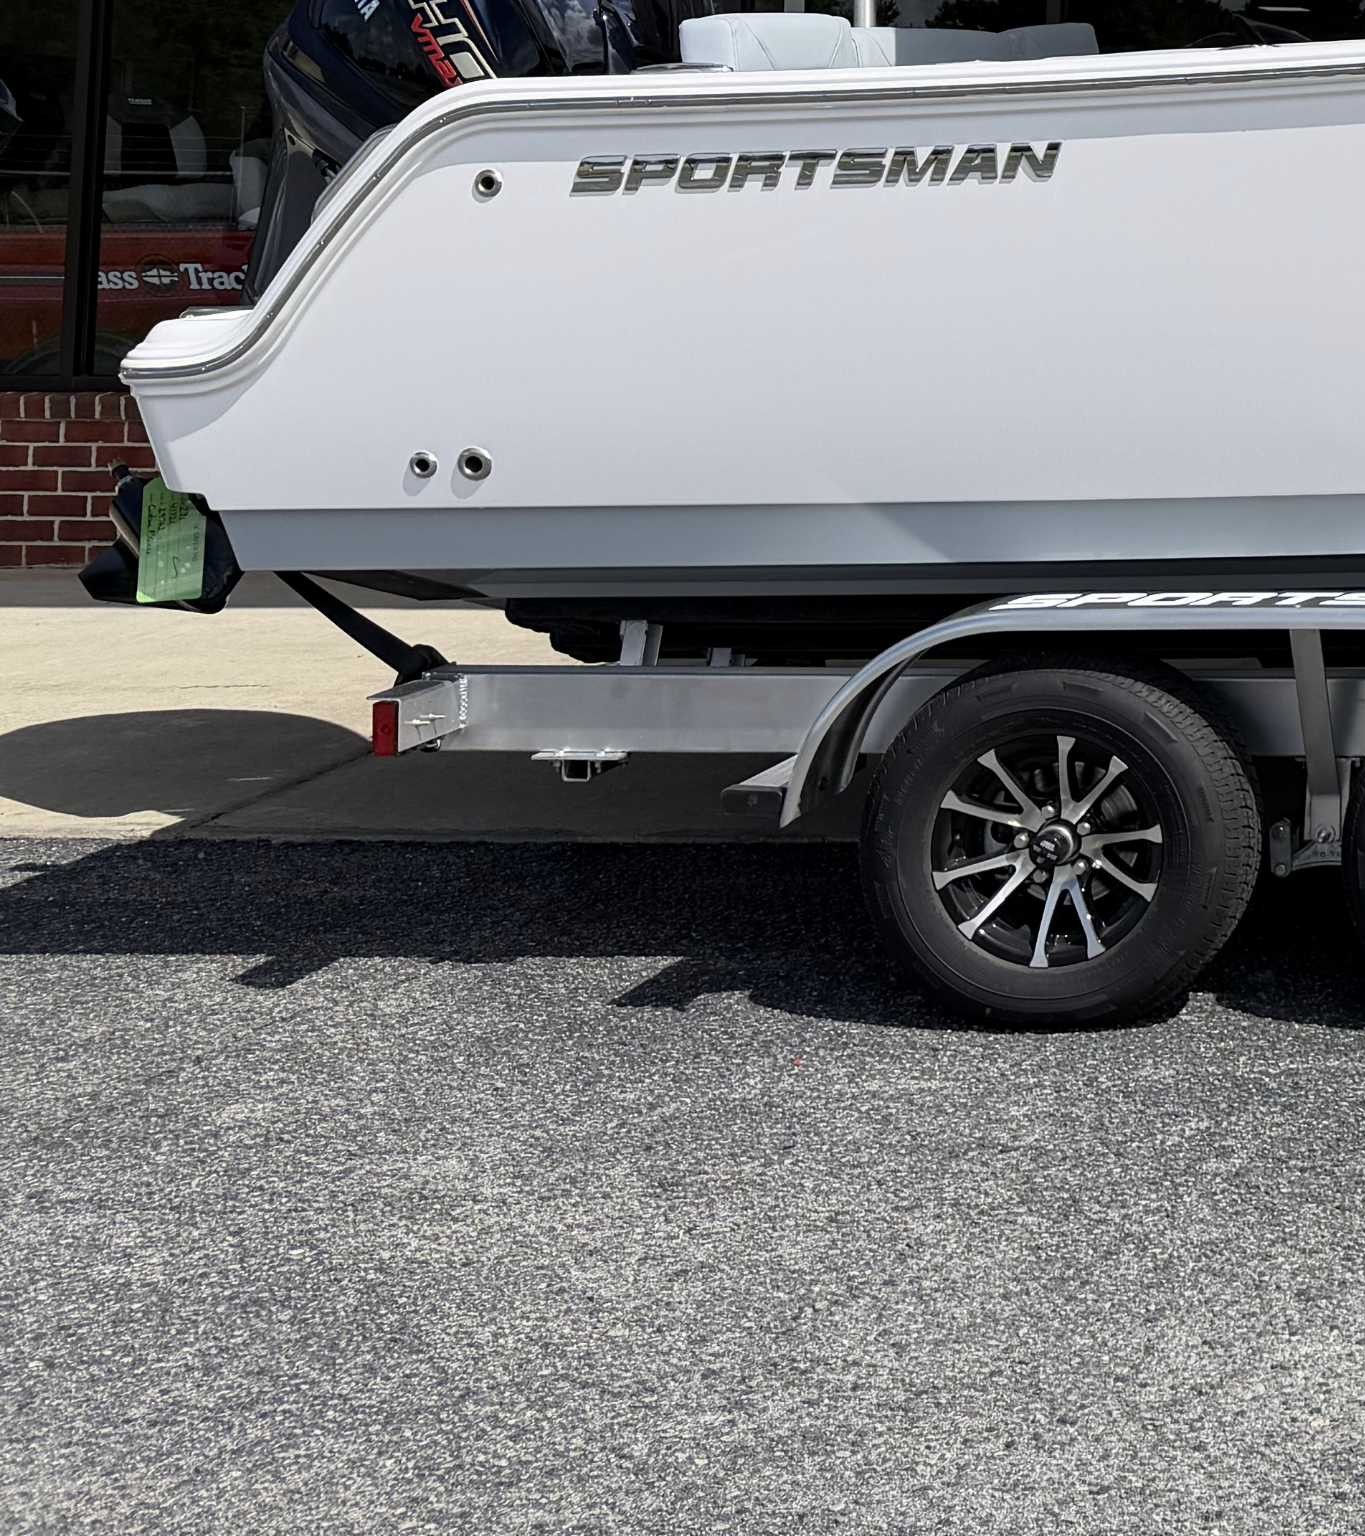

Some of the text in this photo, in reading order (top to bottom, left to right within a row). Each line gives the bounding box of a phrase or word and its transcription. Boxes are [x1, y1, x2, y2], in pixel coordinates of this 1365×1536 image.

[568, 141, 1063, 198] SPORTSMAN
[97, 263, 250, 290] ass Trac
